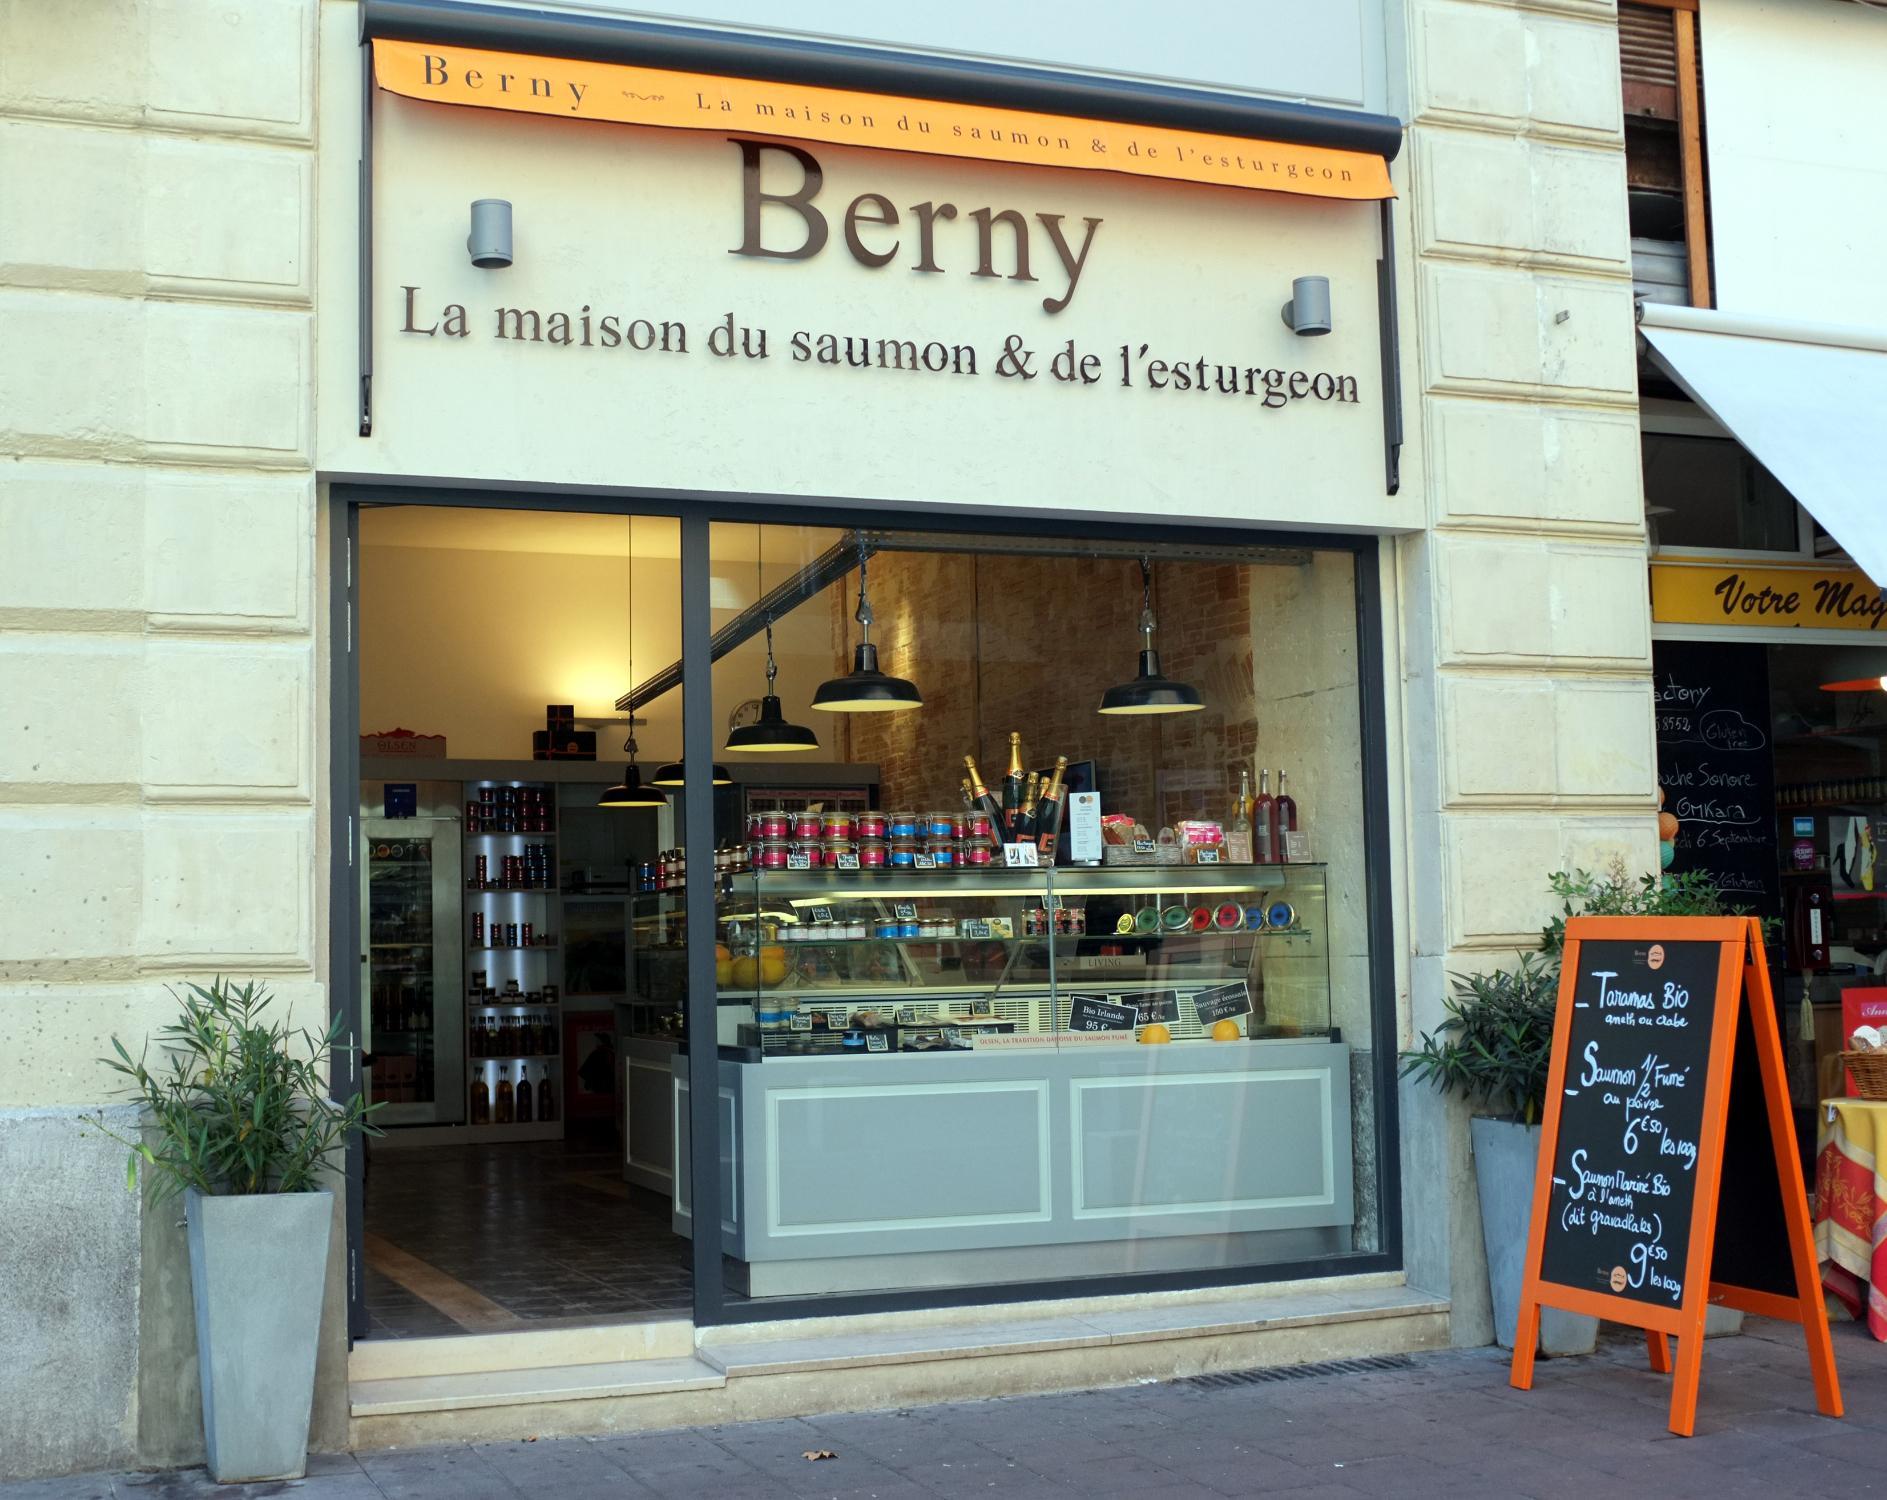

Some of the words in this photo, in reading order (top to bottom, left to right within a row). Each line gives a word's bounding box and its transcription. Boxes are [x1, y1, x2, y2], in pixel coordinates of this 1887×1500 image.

[422, 54, 588, 111] Berny
[696, 93, 732, 112] La
[755, 101, 875, 129] maison
[897, 115, 931, 134] du
[953, 123, 1071, 151] saumon
[1091, 137, 1107, 153] &
[1128, 141, 1158, 159] de
[1177, 147, 1354, 182] l'esturgeon
[727, 138, 1103, 314] Berny
[400, 286, 471, 338] La
[494, 305, 690, 354] maison
[707, 312, 770, 359] du
[790, 329, 980, 376] saumon
[994, 334, 1038, 381] &
[1050, 339, 1102, 385] de
[1120, 343, 1361, 409] l'esturgeon
[1715, 574, 1800, 615] Votre
[1654, 673, 1711, 709] actory
[1698, 762, 1758, 787] Sonore
[1697, 829, 1709, 847] 6
[1088, 957, 1121, 968] LIVING
[1195, 998, 1221, 1010] Sauvage
[1592, 971, 1655, 1009] Taramas
[1083, 1006, 1097, 1015] Bio
[1097, 1008, 1125, 1021] Irlande
[1085, 1020, 1099, 1031] 95
[1138, 1013, 1150, 1022] 65
[1605, 1012, 1635, 1026] aneth
[1638, 1017, 1653, 1026] ou
[1581, 1040, 1636, 1087] Saumon
[1655, 1064, 1690, 1088] Fumé
[1603, 1093, 1620, 1104] au
[1626, 1097, 1664, 1122] poivre
[1660, 1128, 1676, 1155] les
[1677, 1140, 1697, 1170] 100g
[1569, 1149, 1615, 1200] Saumon
[1653, 1174, 1671, 1196] Bio
[1587, 1188, 1597, 1201] à
[1650, 1267, 1662, 1285] les
[1663, 1276, 1681, 1300] 100g
